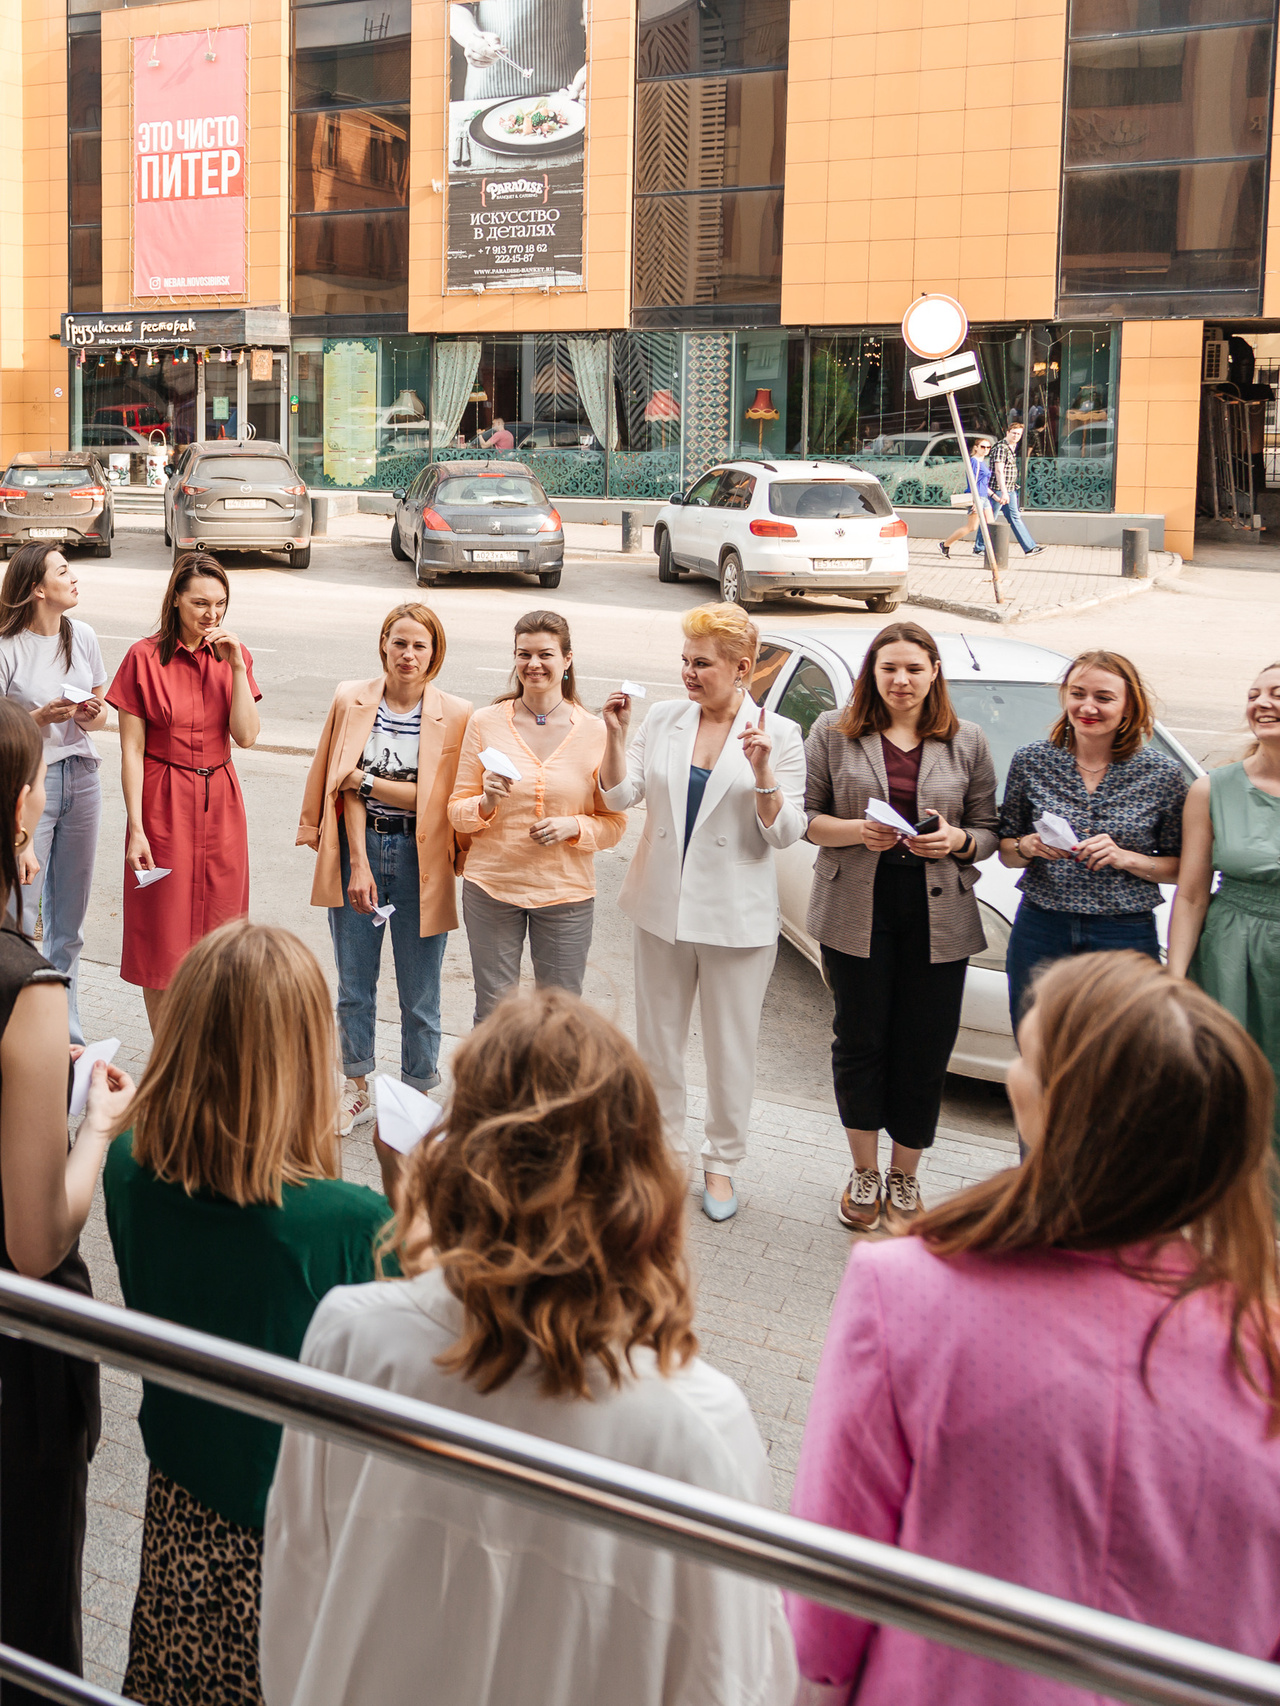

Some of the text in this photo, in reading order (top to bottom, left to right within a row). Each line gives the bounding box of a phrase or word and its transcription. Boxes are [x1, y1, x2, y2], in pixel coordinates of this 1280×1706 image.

[138, 115, 239, 152] ЭТО ЧИСТО
[141, 150, 241, 199] ПИТЕР
[470, 209, 560, 226] ИСКУССТВО
[473, 227, 484, 240] В
[485, 246, 491, 255] 7
[492, 245, 507, 255] 913
[508, 244, 524, 254] 770
[525, 244, 535, 253] 18
[536, 244, 548, 253] 62
[495, 253, 535, 264] 222-15-87
